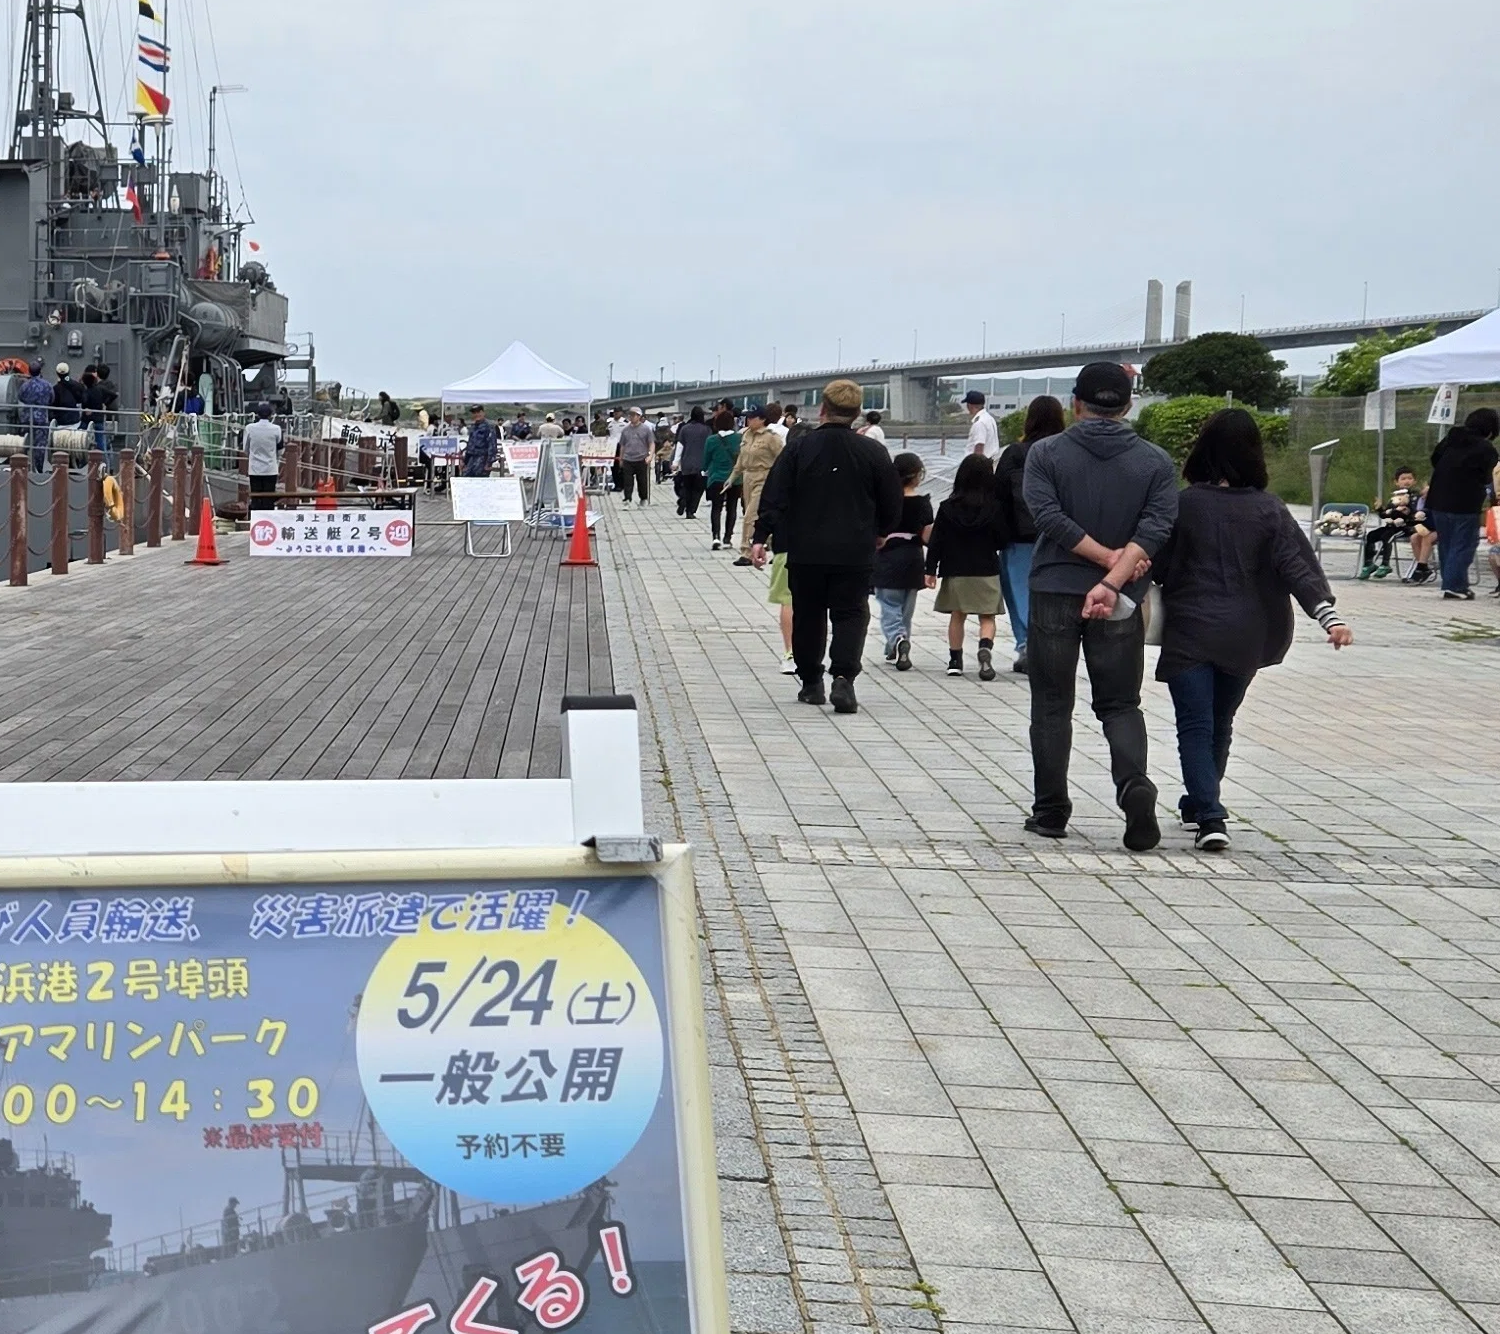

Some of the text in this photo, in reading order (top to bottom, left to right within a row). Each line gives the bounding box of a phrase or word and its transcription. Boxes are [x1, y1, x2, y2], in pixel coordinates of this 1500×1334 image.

[254, 525, 273, 542] 歓
[389, 525, 410, 541] 迎
[249, 890, 590, 939] 災害派遣で活躍！
[379, 1047, 623, 1106] 一般公開
[456, 1133, 566, 1160] 予約不要
